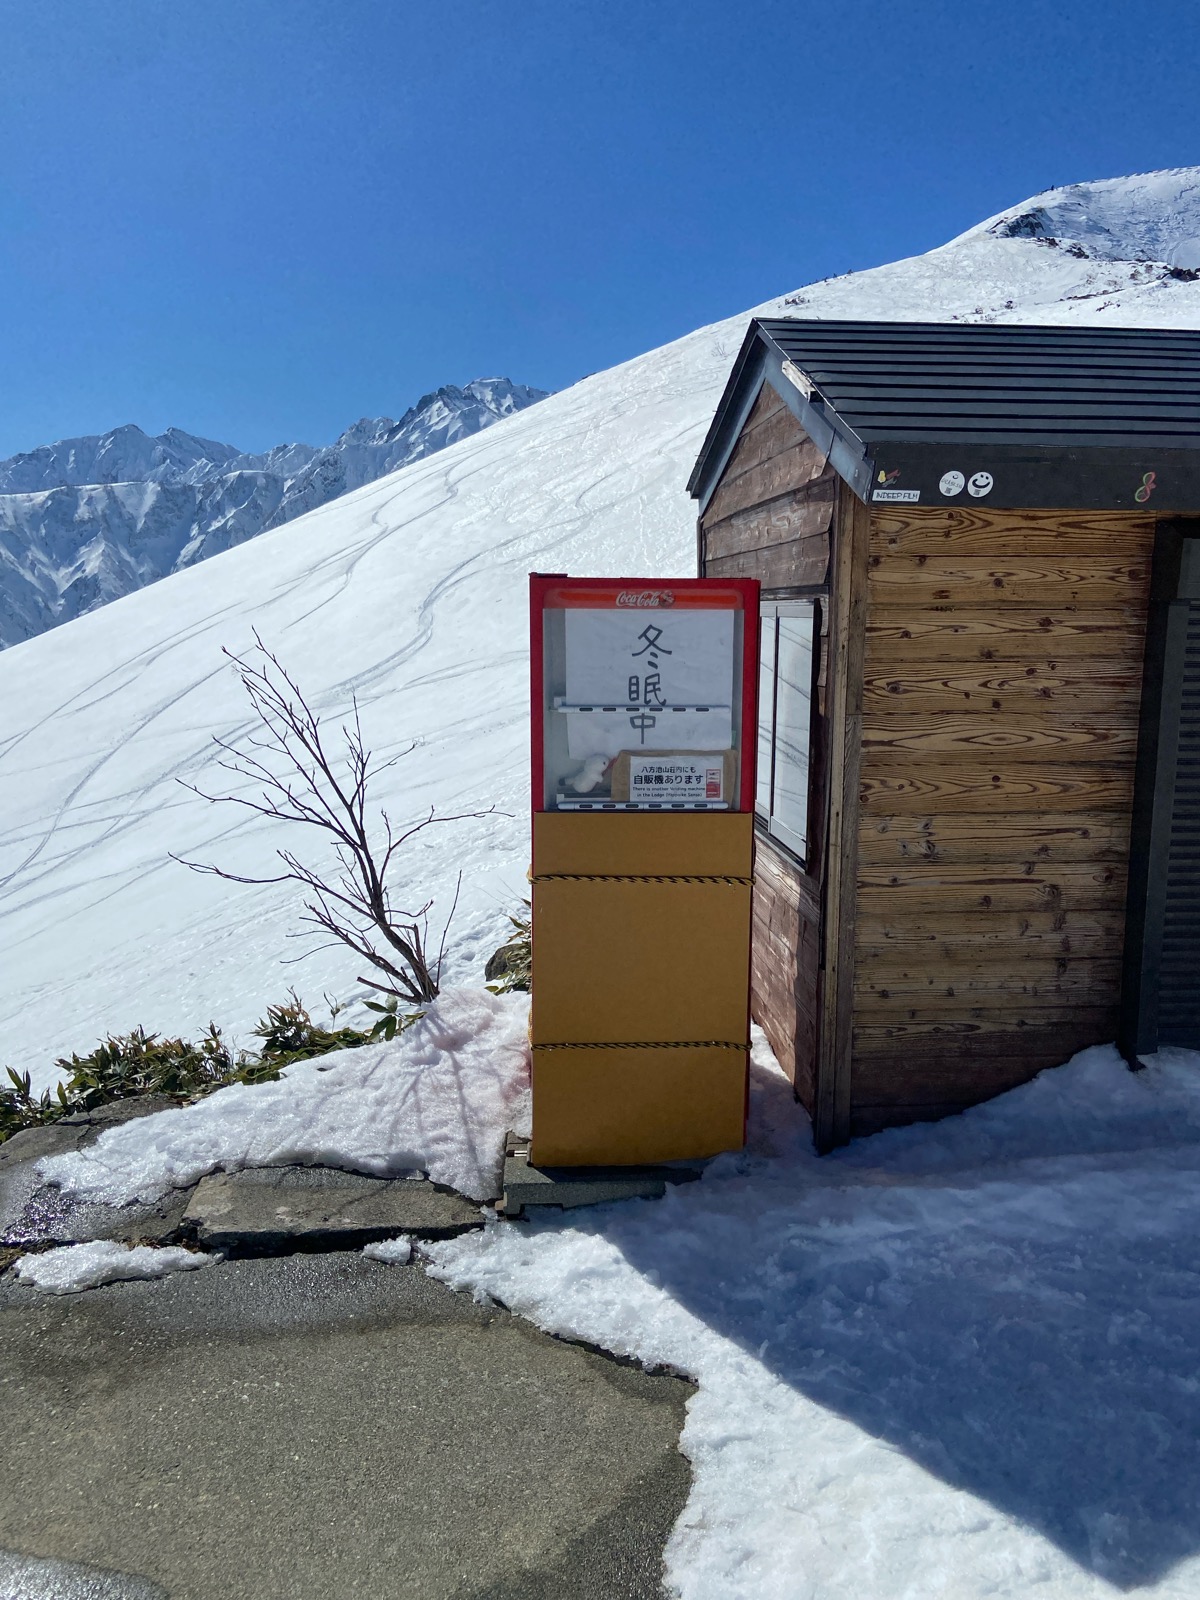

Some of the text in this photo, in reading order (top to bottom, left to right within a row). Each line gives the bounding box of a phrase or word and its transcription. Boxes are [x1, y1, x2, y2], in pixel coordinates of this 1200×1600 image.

[615, 591, 661, 607] Coca-Cola
[628, 624, 673, 744] 冬眠中
[641, 766, 697, 774] 八方池山荘内にも
[633, 774, 704, 785] 自販機あります
